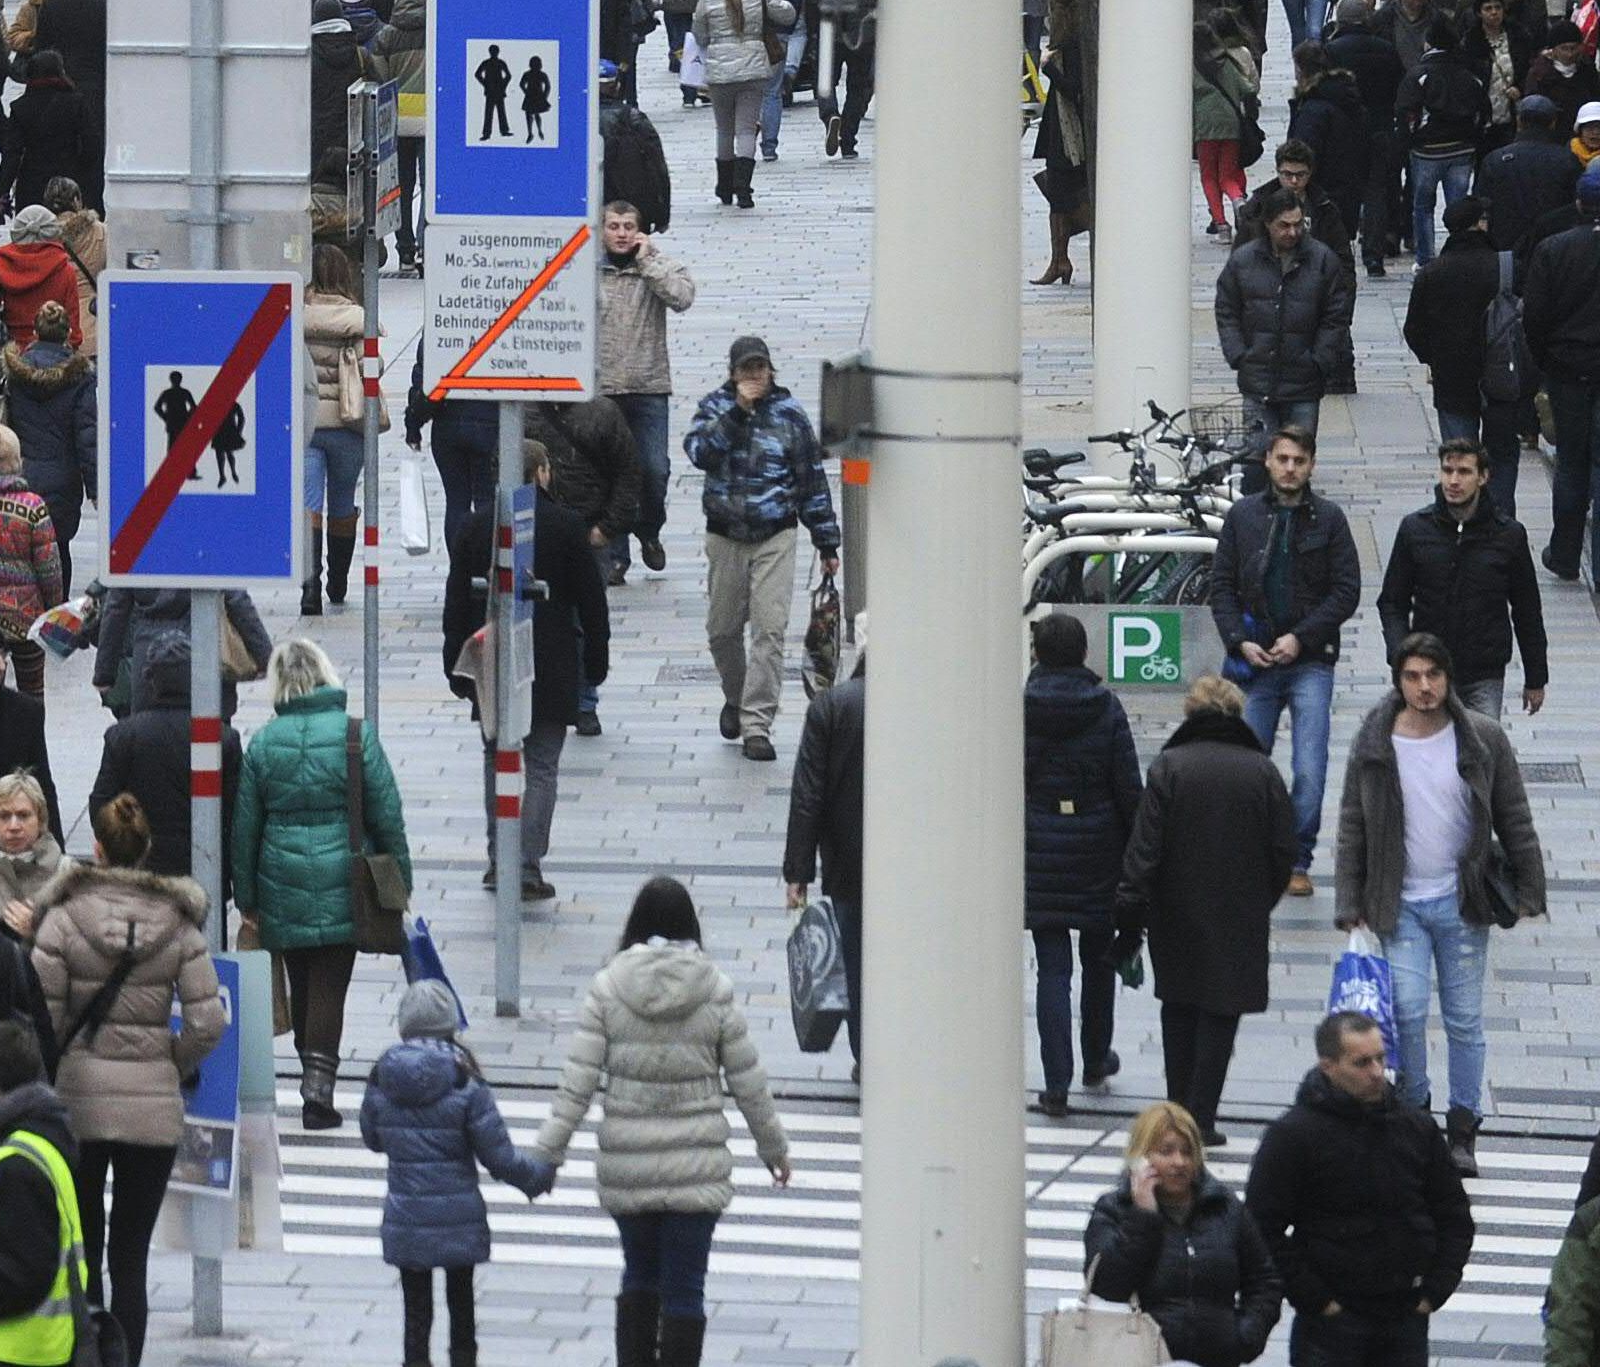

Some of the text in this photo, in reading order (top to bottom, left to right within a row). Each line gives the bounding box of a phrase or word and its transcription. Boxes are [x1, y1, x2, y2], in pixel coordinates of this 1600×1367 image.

[459, 234, 563, 250] ausgenommen
[445, 253, 492, 268] Mo.-Sa.
[461, 274, 481, 290] die
[539, 297, 566, 311] Taxi
[437, 336, 464, 348] zum
[513, 336, 582, 354] Einsteigen
[490, 355, 528, 370] sowie
[1111, 615, 1163, 681] P
